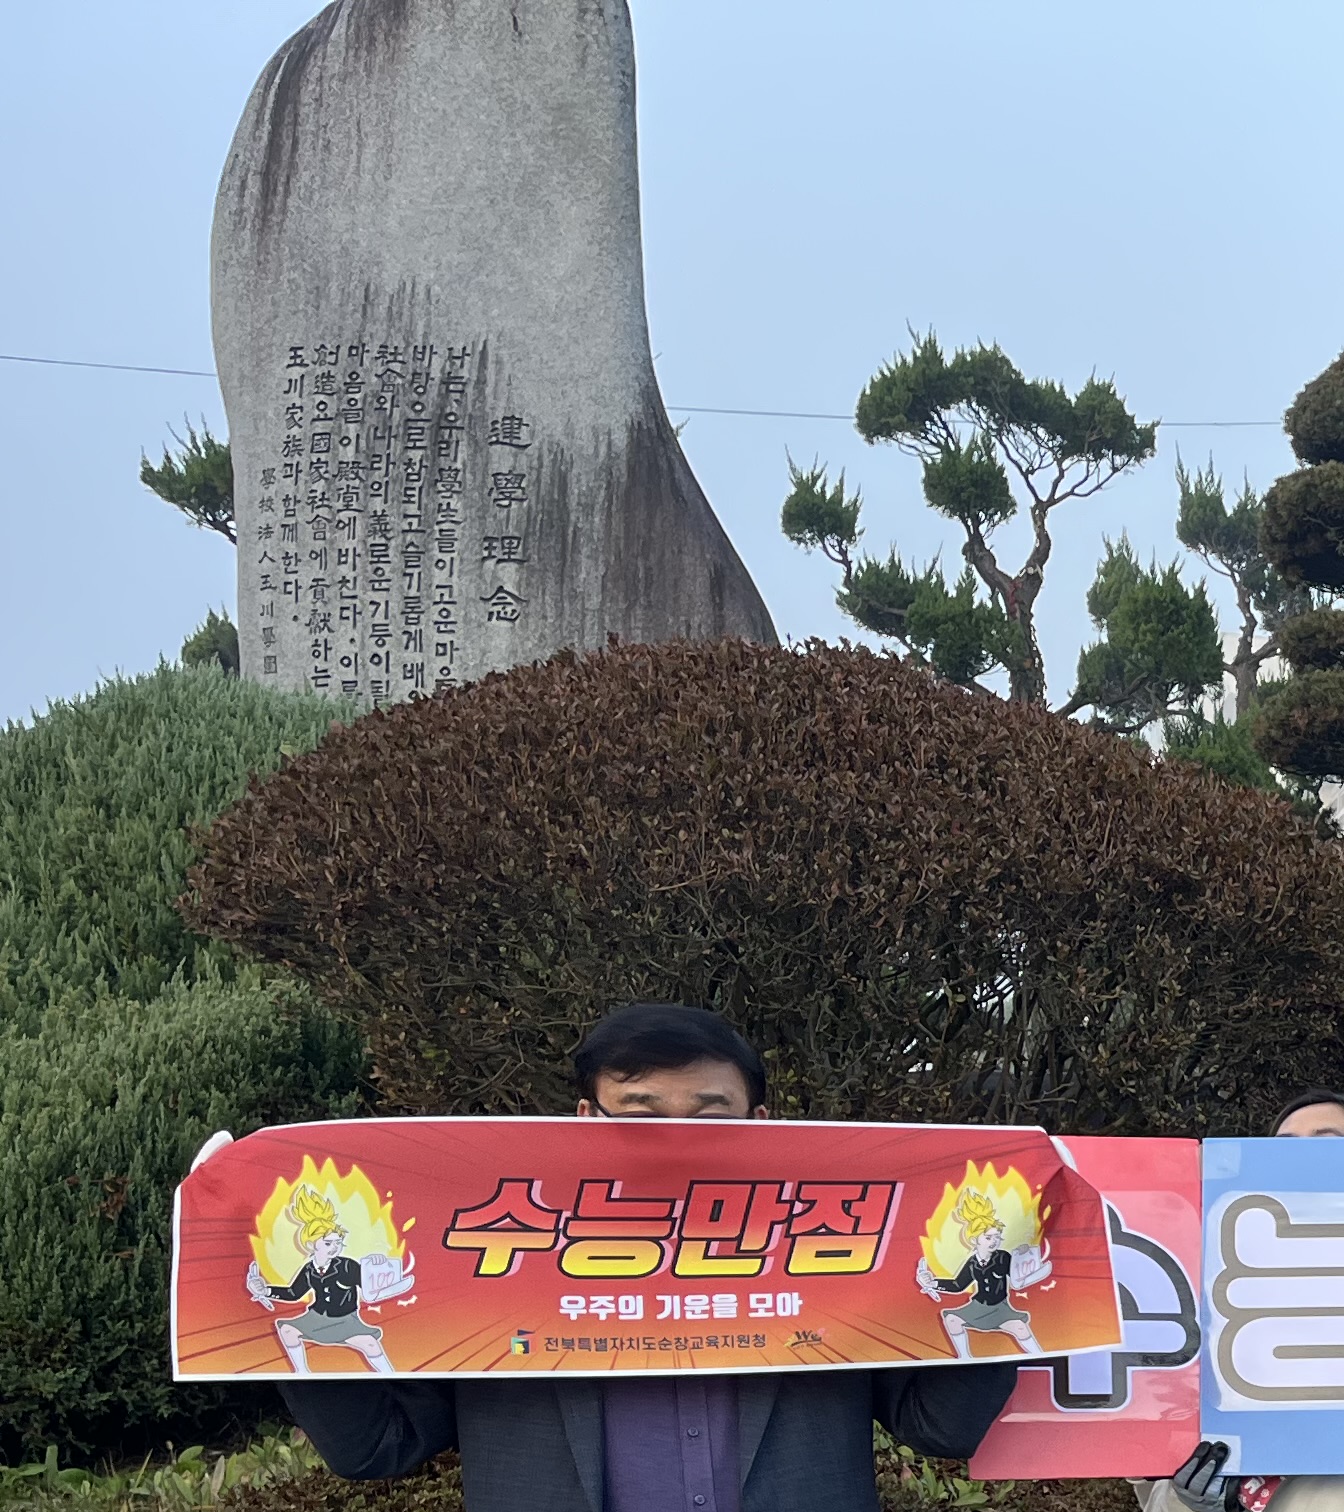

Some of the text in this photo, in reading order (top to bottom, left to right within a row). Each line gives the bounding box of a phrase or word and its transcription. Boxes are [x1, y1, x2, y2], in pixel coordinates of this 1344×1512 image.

[341, 342, 370, 424] 마음을
[374, 344, 407, 419] 社會와
[404, 344, 438, 450] 바탕으로
[369, 425, 397, 505] 나라의
[438, 411, 464, 462] 우리
[479, 413, 532, 623] 建學理念
[432, 584, 458, 634] 고운
[441, 1177, 903, 1280] 수능만점
[543, 1332, 768, 1353] 전북특별자치도순창교육지원청
[558, 1291, 804, 1321] 우주의 기운을 모아
